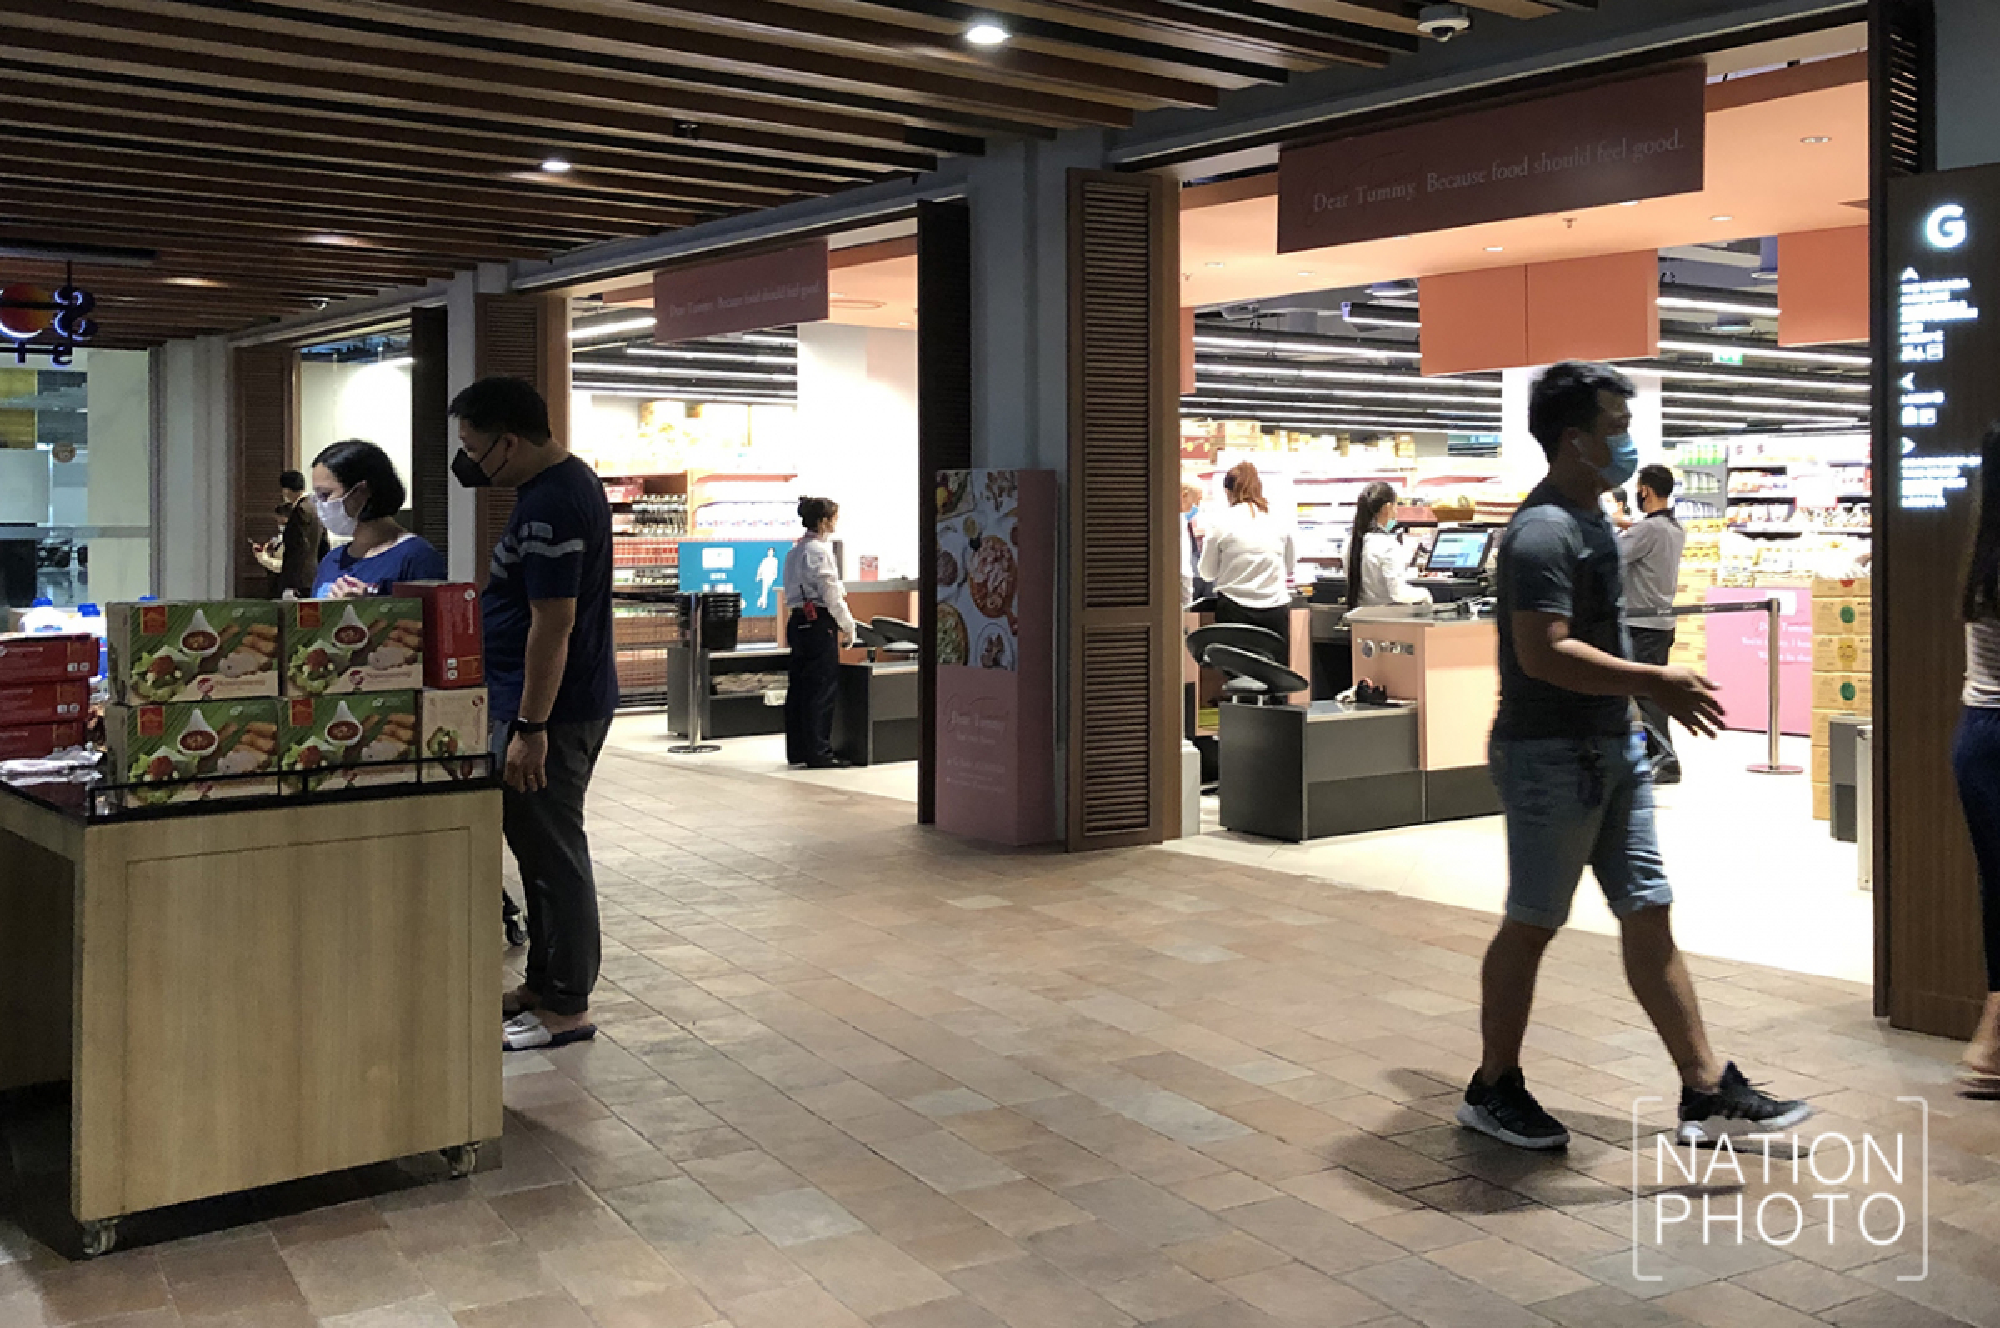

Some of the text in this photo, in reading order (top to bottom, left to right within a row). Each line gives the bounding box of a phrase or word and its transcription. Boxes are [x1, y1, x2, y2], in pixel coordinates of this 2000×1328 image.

[1313, 193, 1349, 213] Dear
[1427, 170, 1487, 193] Because
[1491, 154, 1529, 181] food
[1533, 144, 1591, 174] should
[1597, 137, 1626, 163] feel
[1632, 127, 1684, 164] good.
[1925, 203, 1968, 249] G
